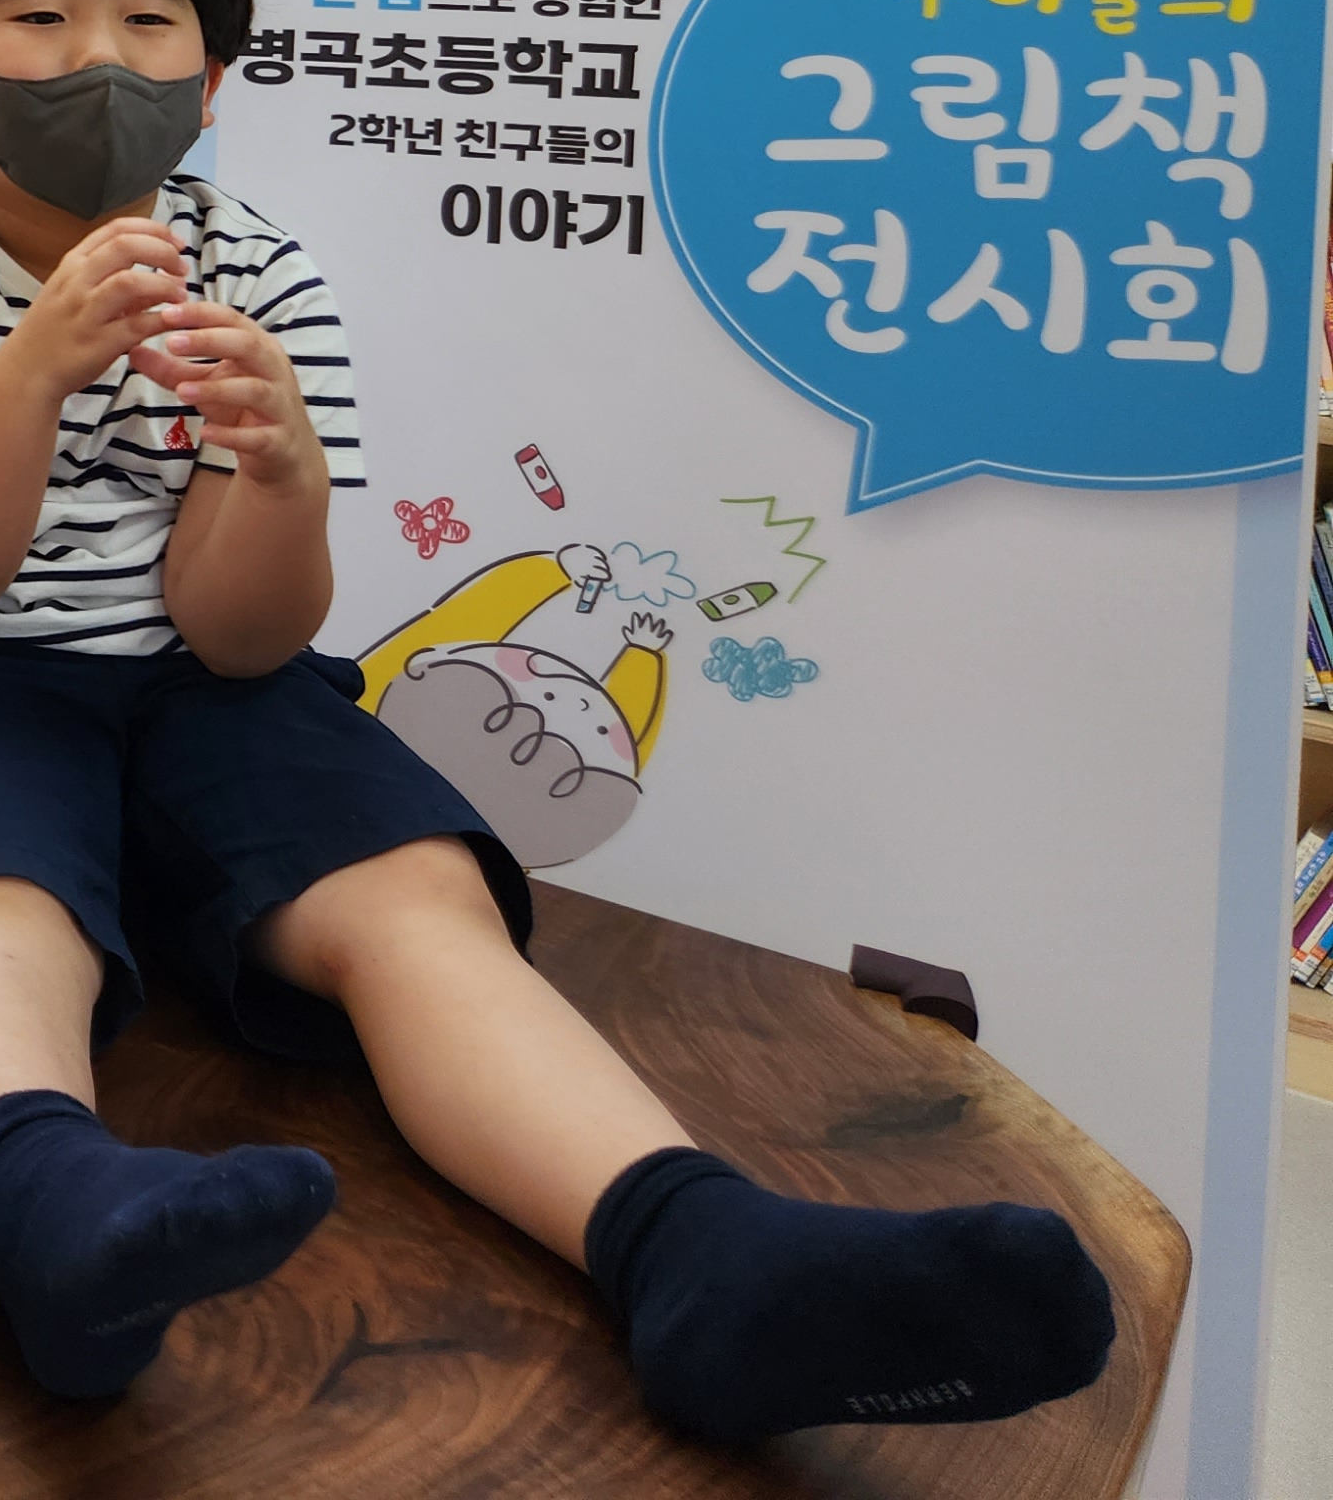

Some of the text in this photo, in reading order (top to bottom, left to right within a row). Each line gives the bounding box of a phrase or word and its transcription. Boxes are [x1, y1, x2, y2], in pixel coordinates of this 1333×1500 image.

[237, 29, 641, 100] 병곡초등학교
[328, 113, 636, 169] 2학년 친구들의
[764, 45, 1268, 221] 그림책
[440, 182, 645, 256] 이야기
[745, 208, 1269, 375] 전시회
